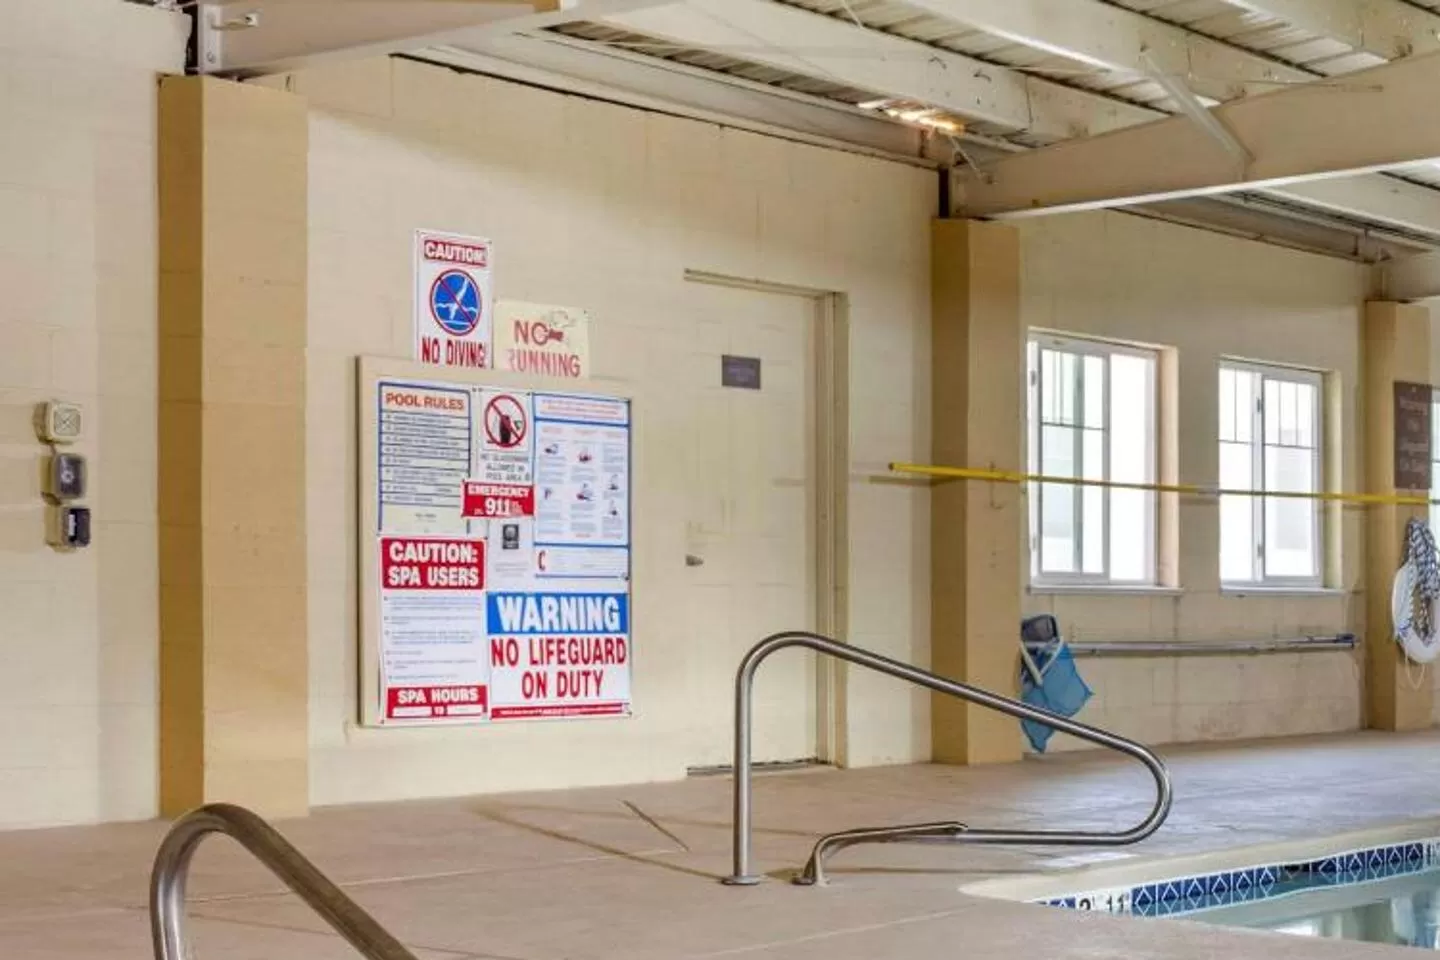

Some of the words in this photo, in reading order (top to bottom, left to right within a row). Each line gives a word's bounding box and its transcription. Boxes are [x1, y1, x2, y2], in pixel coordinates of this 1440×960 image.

[421, 337, 441, 364] NO
[385, 392, 421, 407] POOL
[423, 396, 465, 411] RULES
[485, 497, 511, 516] 911
[389, 542, 478, 564] CAUTION:
[388, 566, 421, 586] SPA
[427, 567, 479, 587] USERS
[496, 597, 621, 632] WARNING
[490, 638, 520, 668] NO
[528, 638, 627, 666] LIFEGUARD
[397, 689, 428, 704] SPA
[431, 687, 479, 703] HOURS
[521, 672, 548, 699] ON
[556, 671, 604, 698] DUTY
